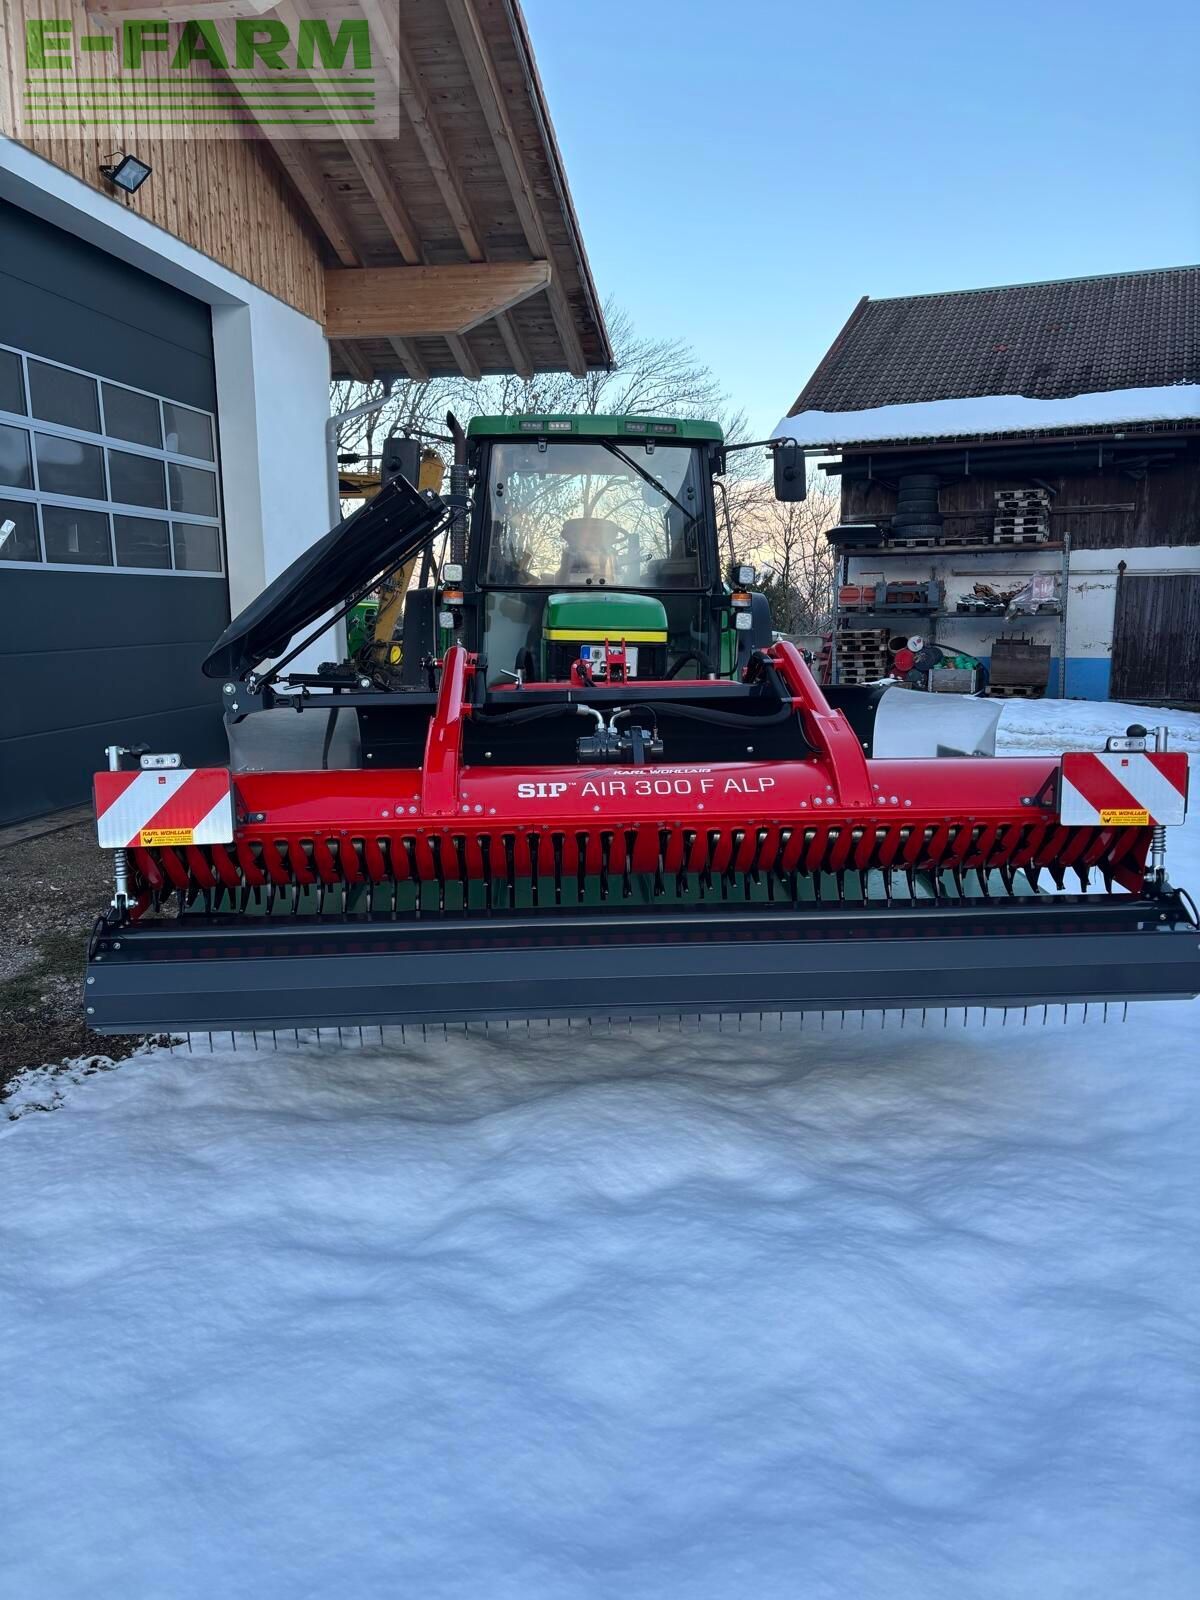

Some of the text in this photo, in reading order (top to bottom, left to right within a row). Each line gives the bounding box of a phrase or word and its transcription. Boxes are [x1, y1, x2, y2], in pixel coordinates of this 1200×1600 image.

[581, 781, 626, 797] AIR
[635, 779, 692, 795] 300
[701, 778, 714, 794] F
[724, 777, 775, 793] ALP
